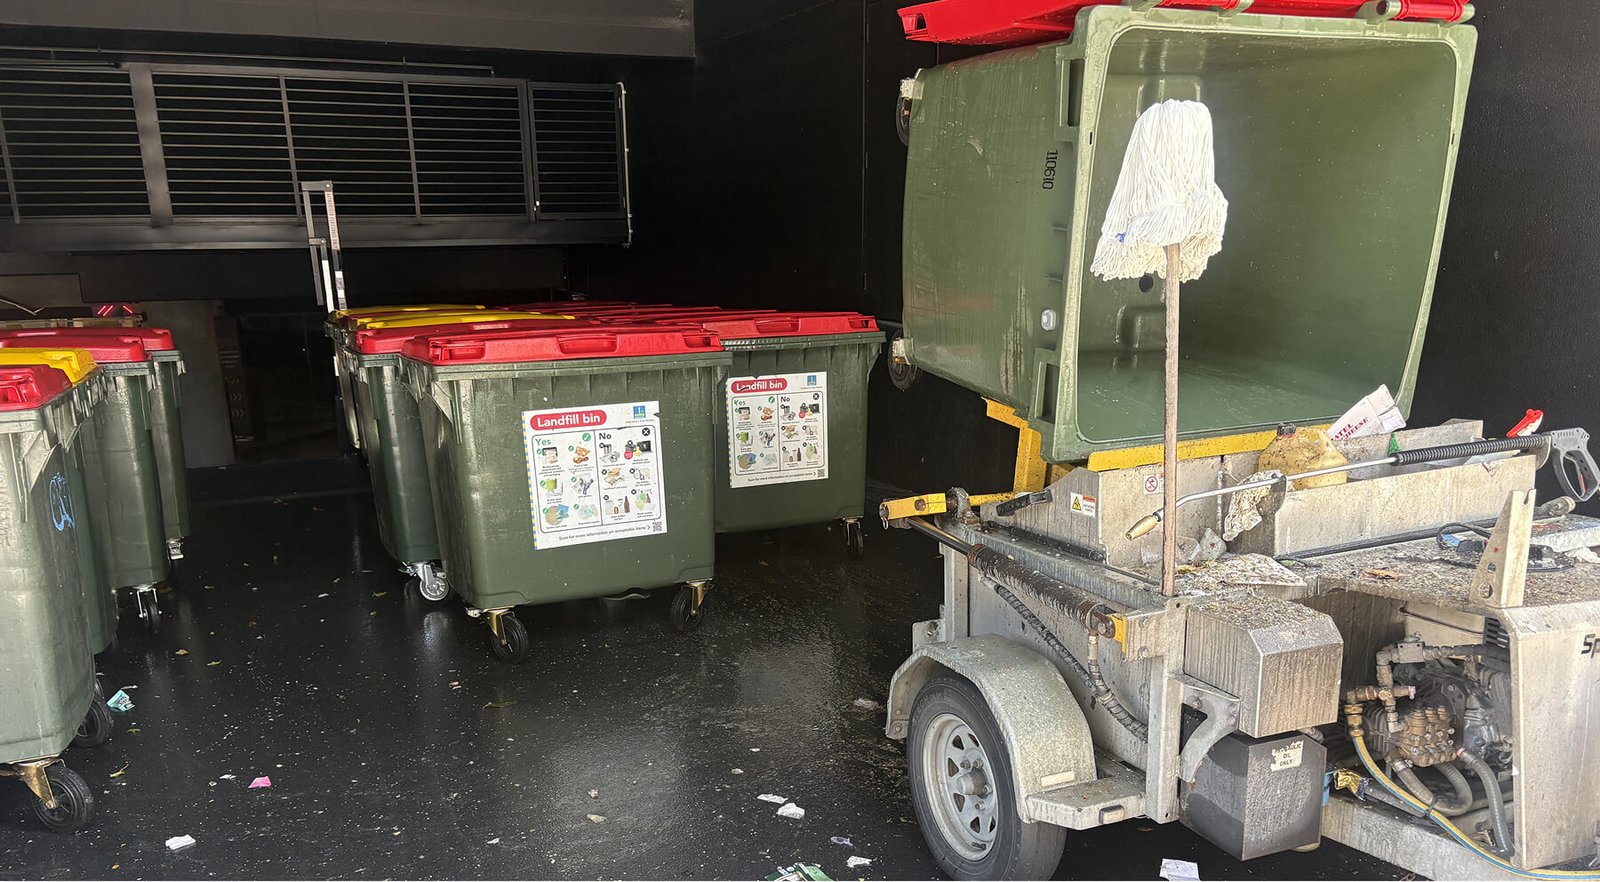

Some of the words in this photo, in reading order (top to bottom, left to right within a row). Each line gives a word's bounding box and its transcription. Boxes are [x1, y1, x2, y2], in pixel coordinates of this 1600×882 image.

[1042, 149, 1058, 190] 110610
[736, 380, 767, 391] Landfill
[769, 379, 783, 389] bin
[536, 414, 580, 428] Landfill
[582, 412, 601, 424] bin
[598, 432, 612, 440] No
[1331, 423, 1353, 441] ATEL
[534, 438, 552, 446] Yes
